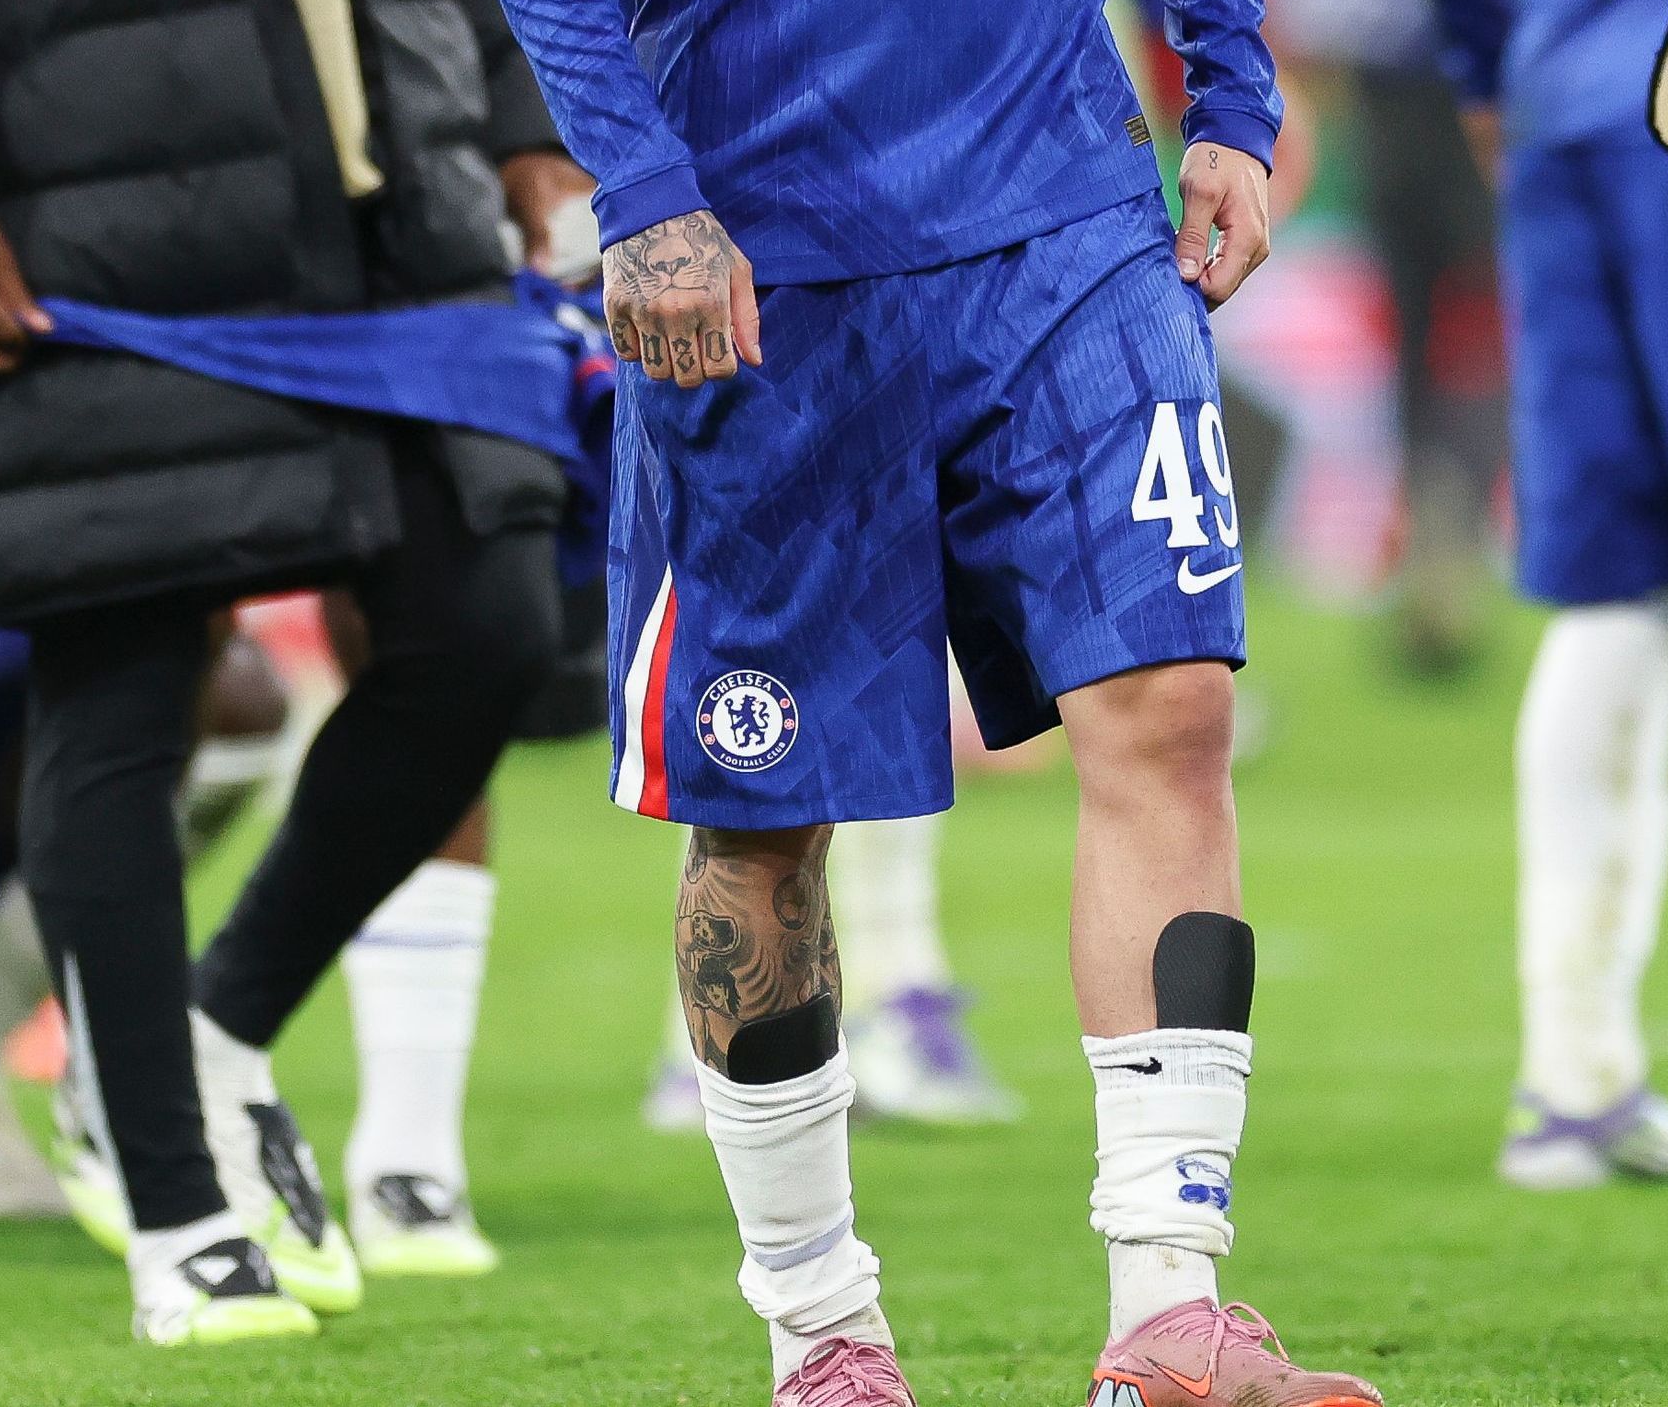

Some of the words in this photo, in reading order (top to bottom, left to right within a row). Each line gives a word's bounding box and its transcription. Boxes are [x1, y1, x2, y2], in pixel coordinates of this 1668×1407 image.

[1132, 401, 1240, 550] 49
[709, 673, 772, 701] CHELSEA
[720, 752, 765, 767] FOOTBALL
[767, 741, 786, 760] CLUB
